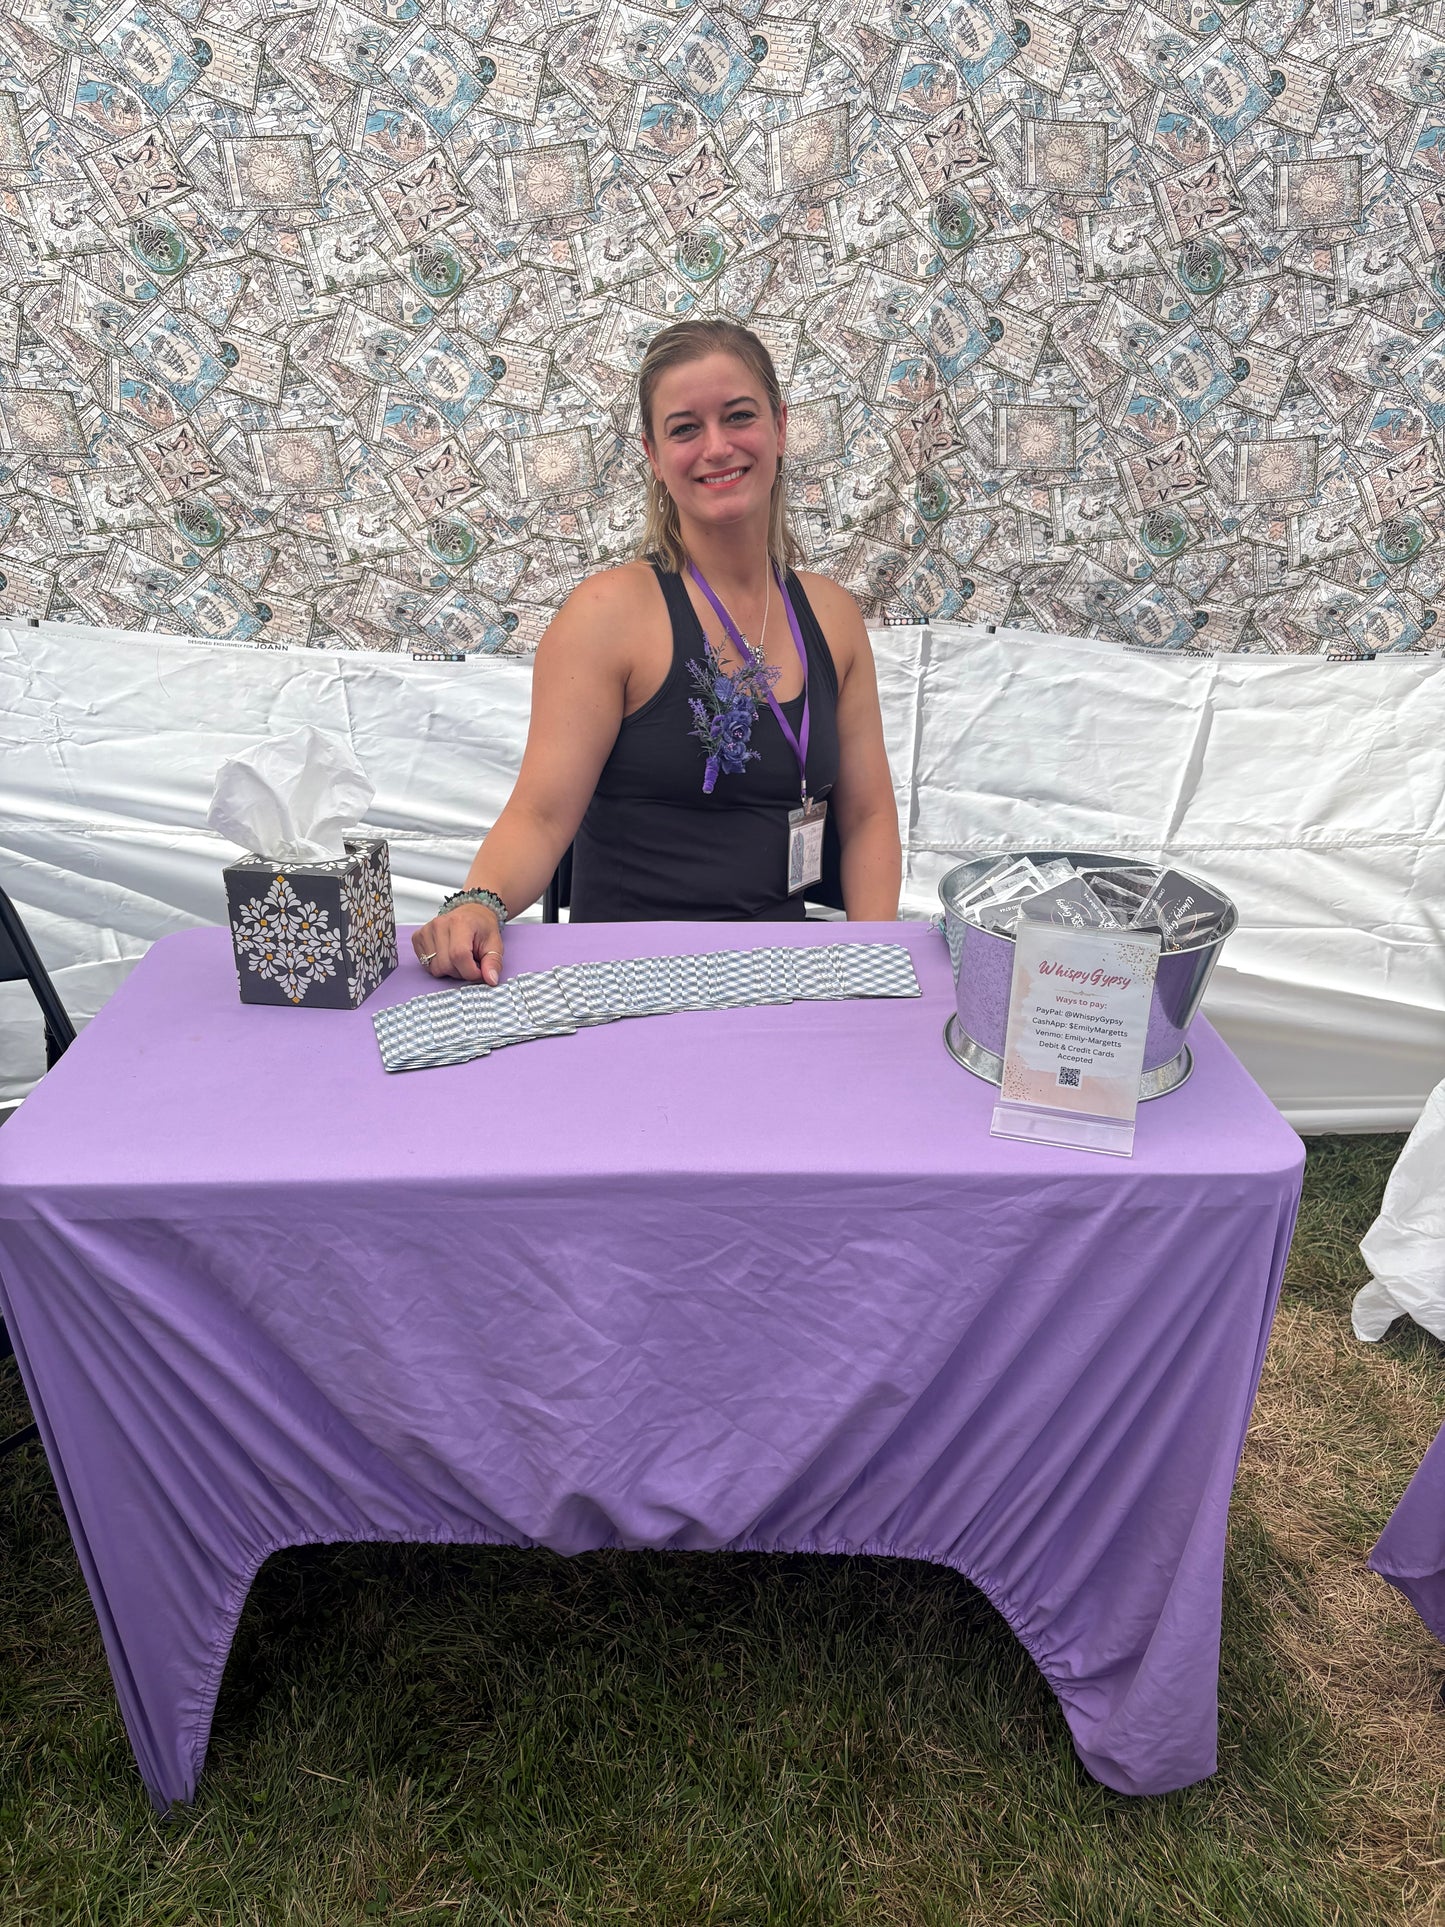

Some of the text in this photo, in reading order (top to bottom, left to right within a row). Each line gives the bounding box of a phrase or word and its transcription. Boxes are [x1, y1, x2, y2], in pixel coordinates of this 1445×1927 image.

[66, 71, 76, 103] STRENGTH
[891, 62, 904, 94] STRENGTH
[356, 103, 368, 135] STRENGTH
[631, 102, 642, 133] STRENGTH
[1148, 104, 1160, 132] STRENGTH
[1406, 122, 1422, 153] STRENGTH
[880, 358, 892, 386] STRENGTH
[1118, 388, 1132, 415] STRENGTH
[1361, 405, 1377, 433] STRENGTH
[254, 643, 288, 651] JOANN
[1056, 996, 1077, 1005] Ways
[1090, 1001, 1107, 1009] pay:
[1032, 1017, 1128, 1037] CashApp: $EmilyMargetts
[1036, 1007, 1124, 1026] PayPal: @WhispyGypsy
[1035, 1029, 1122, 1048] Venmo: Emily-Margetts
[1039, 1041, 1059, 1050] Debit
[1068, 1046, 1090, 1055] Credit
[1092, 1049, 1115, 1058] Cards
[1057, 1053, 1093, 1064] Accepted
